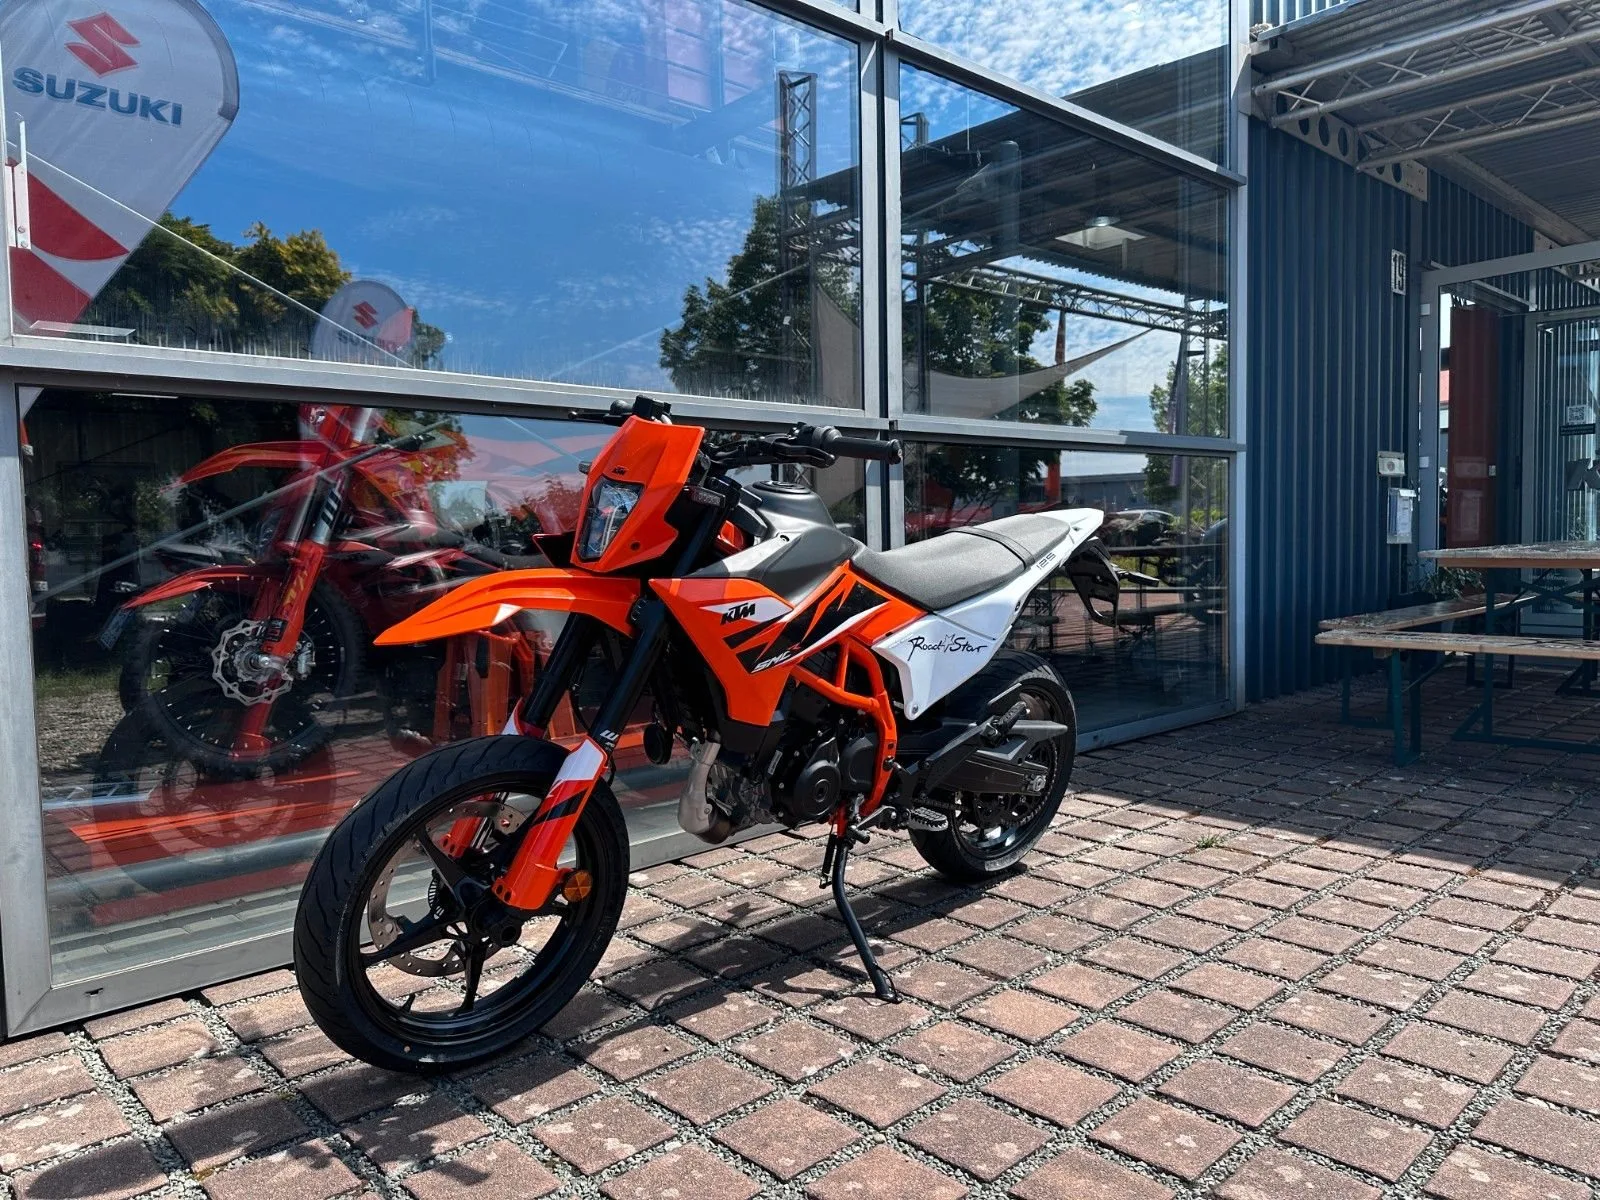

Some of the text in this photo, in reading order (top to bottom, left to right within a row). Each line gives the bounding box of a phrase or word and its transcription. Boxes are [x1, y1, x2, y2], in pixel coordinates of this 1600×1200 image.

[12, 66, 182, 127] SUZUKI
[1392, 253, 1405, 291] 19
[1036, 552, 1056, 570] 125
[720, 602, 756, 625] KTM
[907, 636, 987, 661] Road Star
